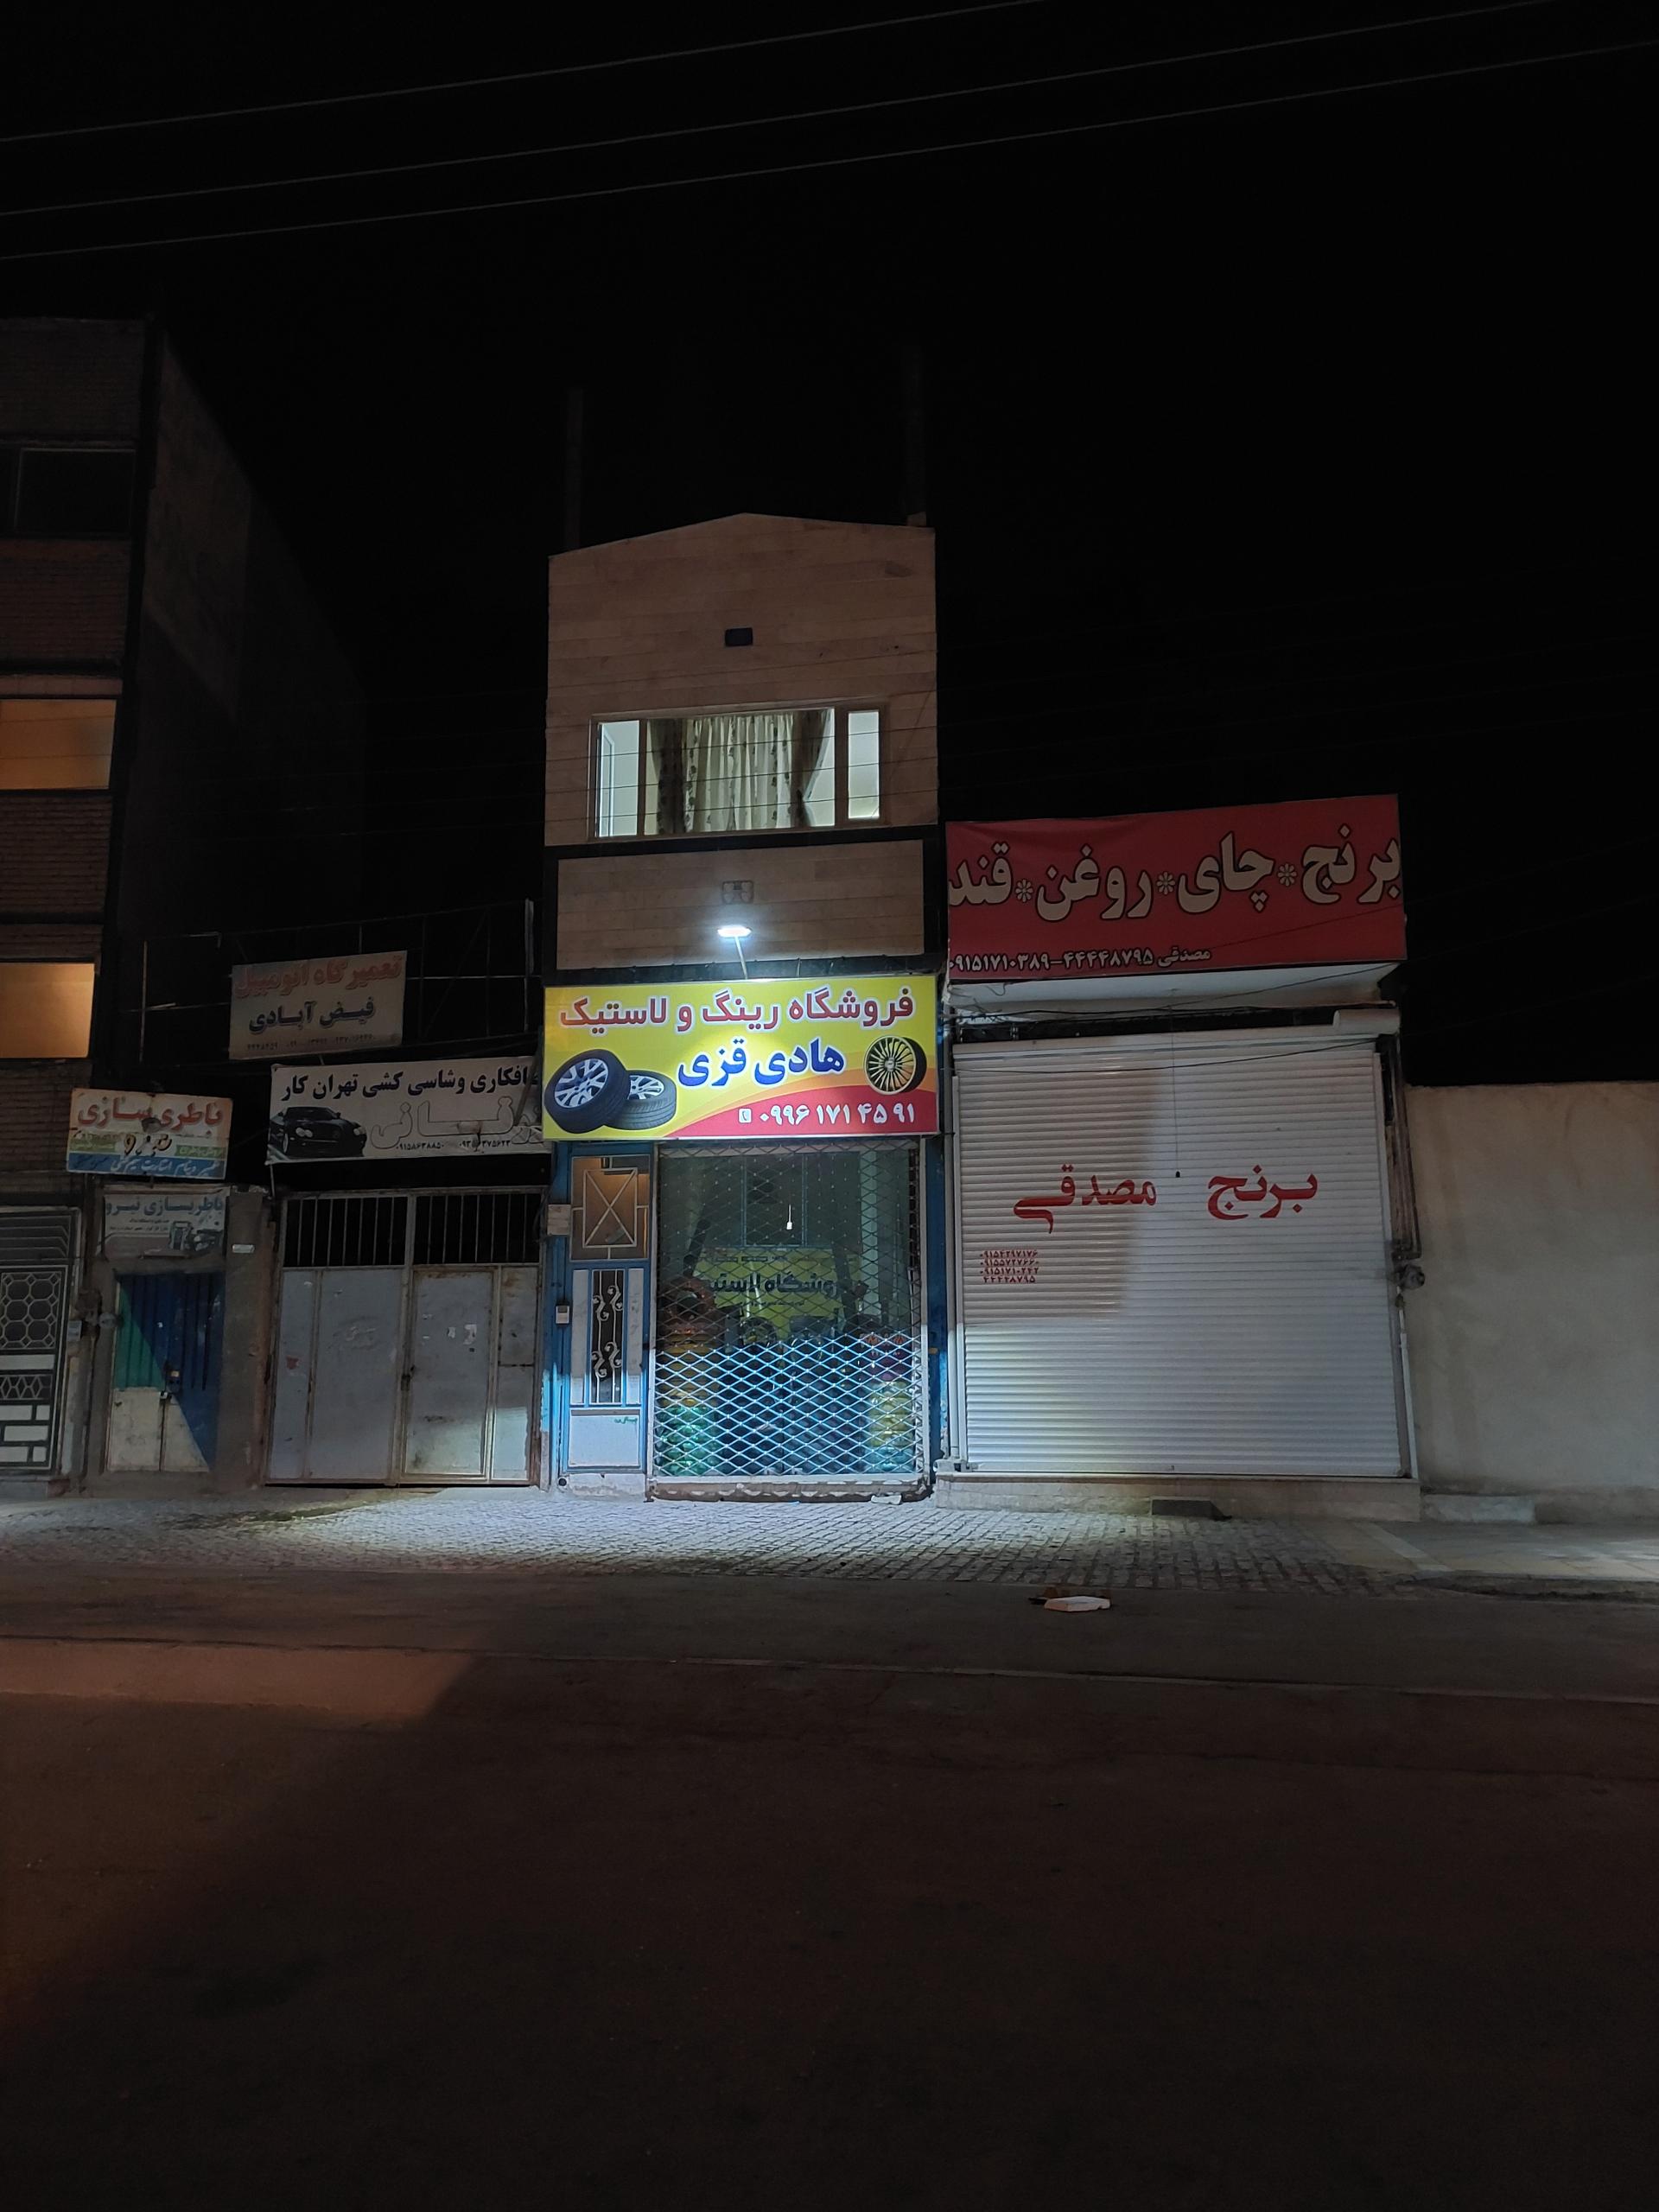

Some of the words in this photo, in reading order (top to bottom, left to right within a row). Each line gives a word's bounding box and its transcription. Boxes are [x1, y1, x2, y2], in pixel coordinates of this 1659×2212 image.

[949, 842, 1013, 906] قند
[1036, 845, 1153, 922] روغن
[1177, 831, 1274, 912] چای
[1301, 824, 1402, 905] برنج
[1156, 947, 1211, 968] مصدقی
[560, 997, 667, 1034] لاستیک
[677, 1005, 692, 1032] و
[702, 989, 779, 1030] رینگ
[788, 987, 914, 1027] فروشگاه
[677, 1038, 747, 1087] قزی
[754, 1038, 844, 1085] هادی
[281, 1075, 308, 1102] کار
[313, 1073, 359, 1099] تهران
[363, 1071, 404, 1097] کشی
[760, 1103, 810, 1126] ۰۹۹۶
[816, 1103, 852, 1125] ۱۷۱
[856, 1103, 888, 1125] ۴۵
[893, 1103, 915, 1123] ۹۱
[1014, 1163, 1157, 1235] مصدقی
[1207, 1164, 1319, 1221] برنج
